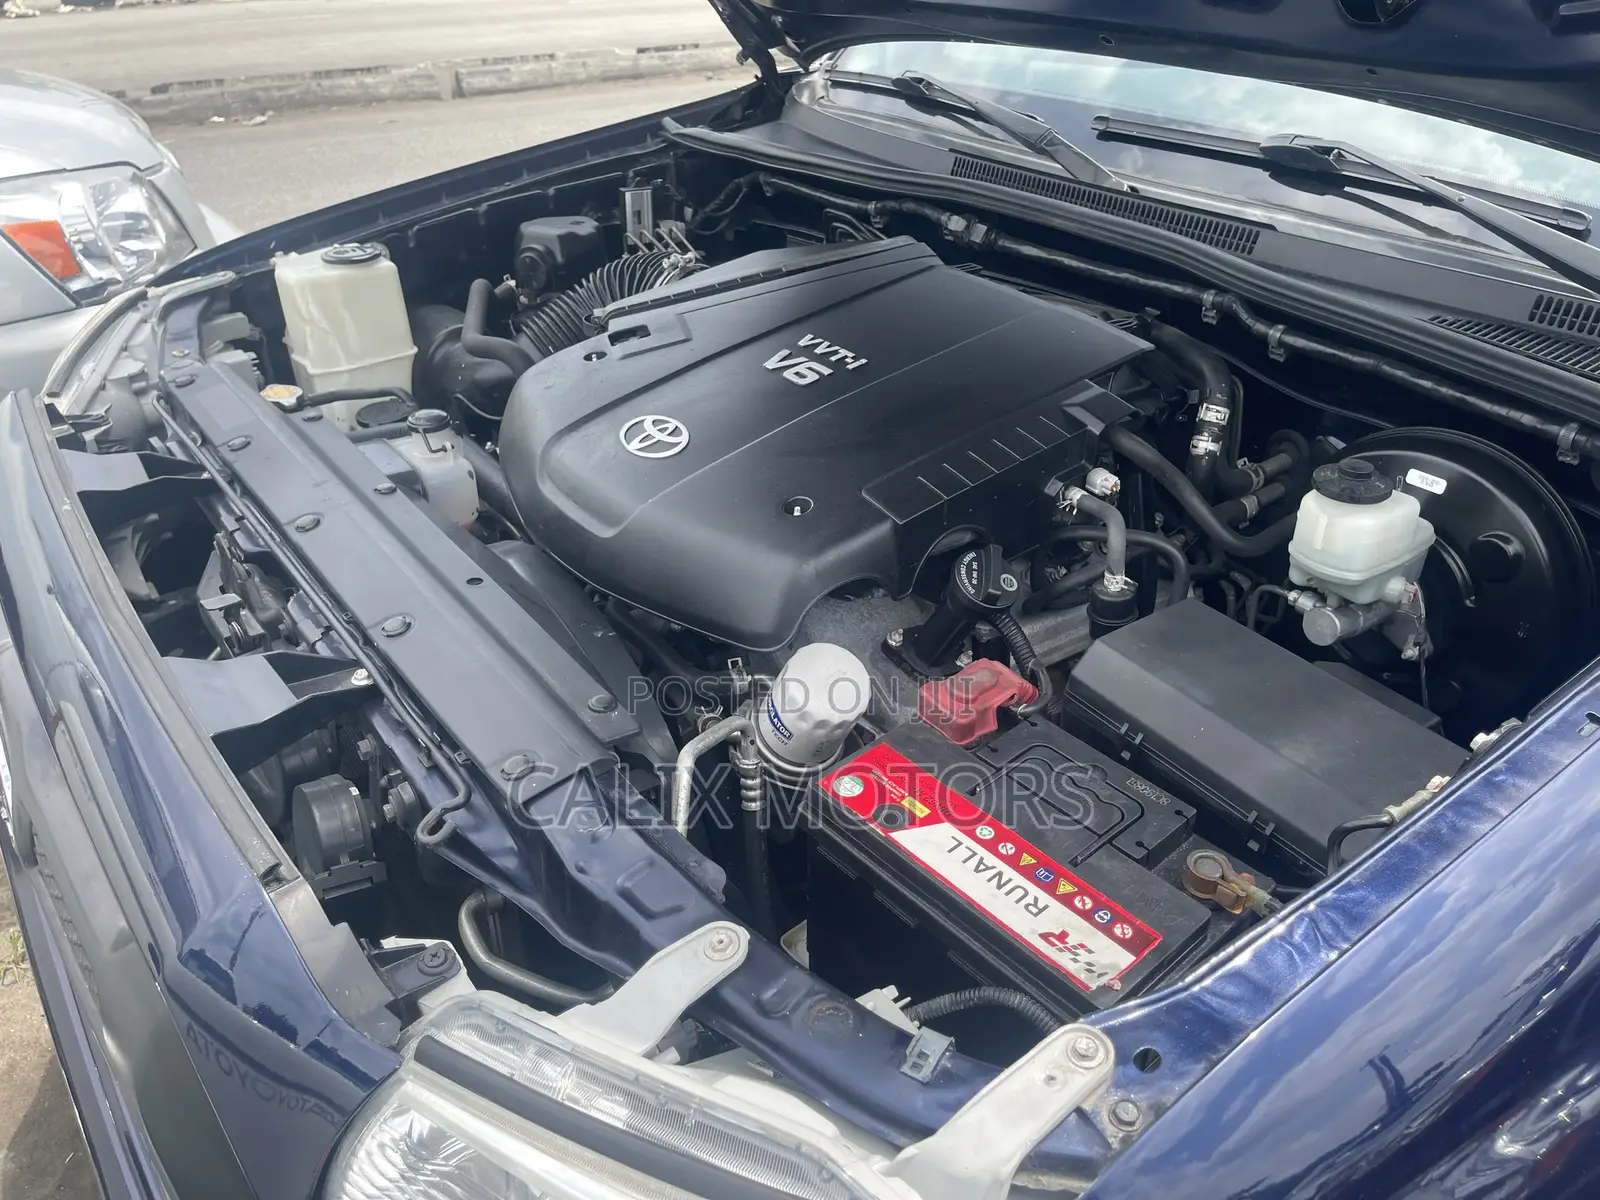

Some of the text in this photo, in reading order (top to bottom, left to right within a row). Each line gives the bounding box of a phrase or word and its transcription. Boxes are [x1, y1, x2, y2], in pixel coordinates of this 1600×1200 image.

[763, 348, 834, 386] V6
[960, 551, 977, 595] ENERGY CONSERVING
[771, 729, 788, 746] TECH
[947, 835, 1049, 918] RUNALL
